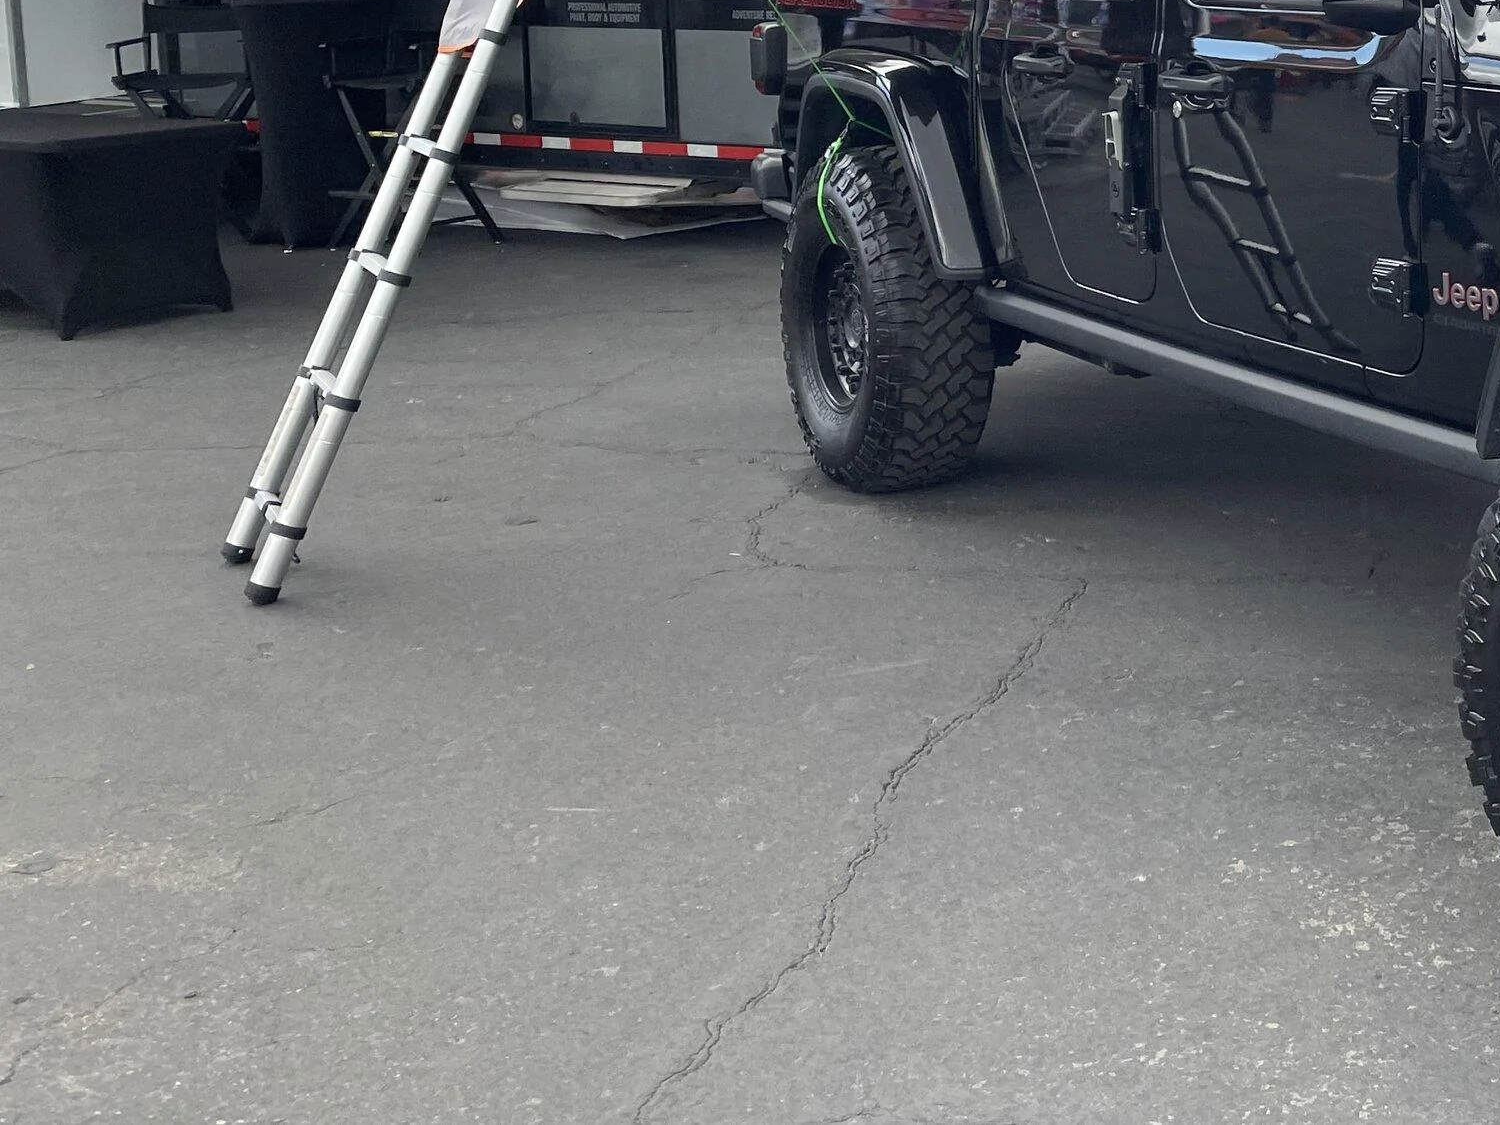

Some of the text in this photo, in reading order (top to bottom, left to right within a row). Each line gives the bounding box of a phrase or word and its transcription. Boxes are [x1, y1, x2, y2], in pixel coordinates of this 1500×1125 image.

[567, 2, 642, 13] PROFESSIONAL AUTOMOTIVE
[609, 13, 640, 23] EQUIPMENT
[1432, 272, 1499, 321] Jeep
